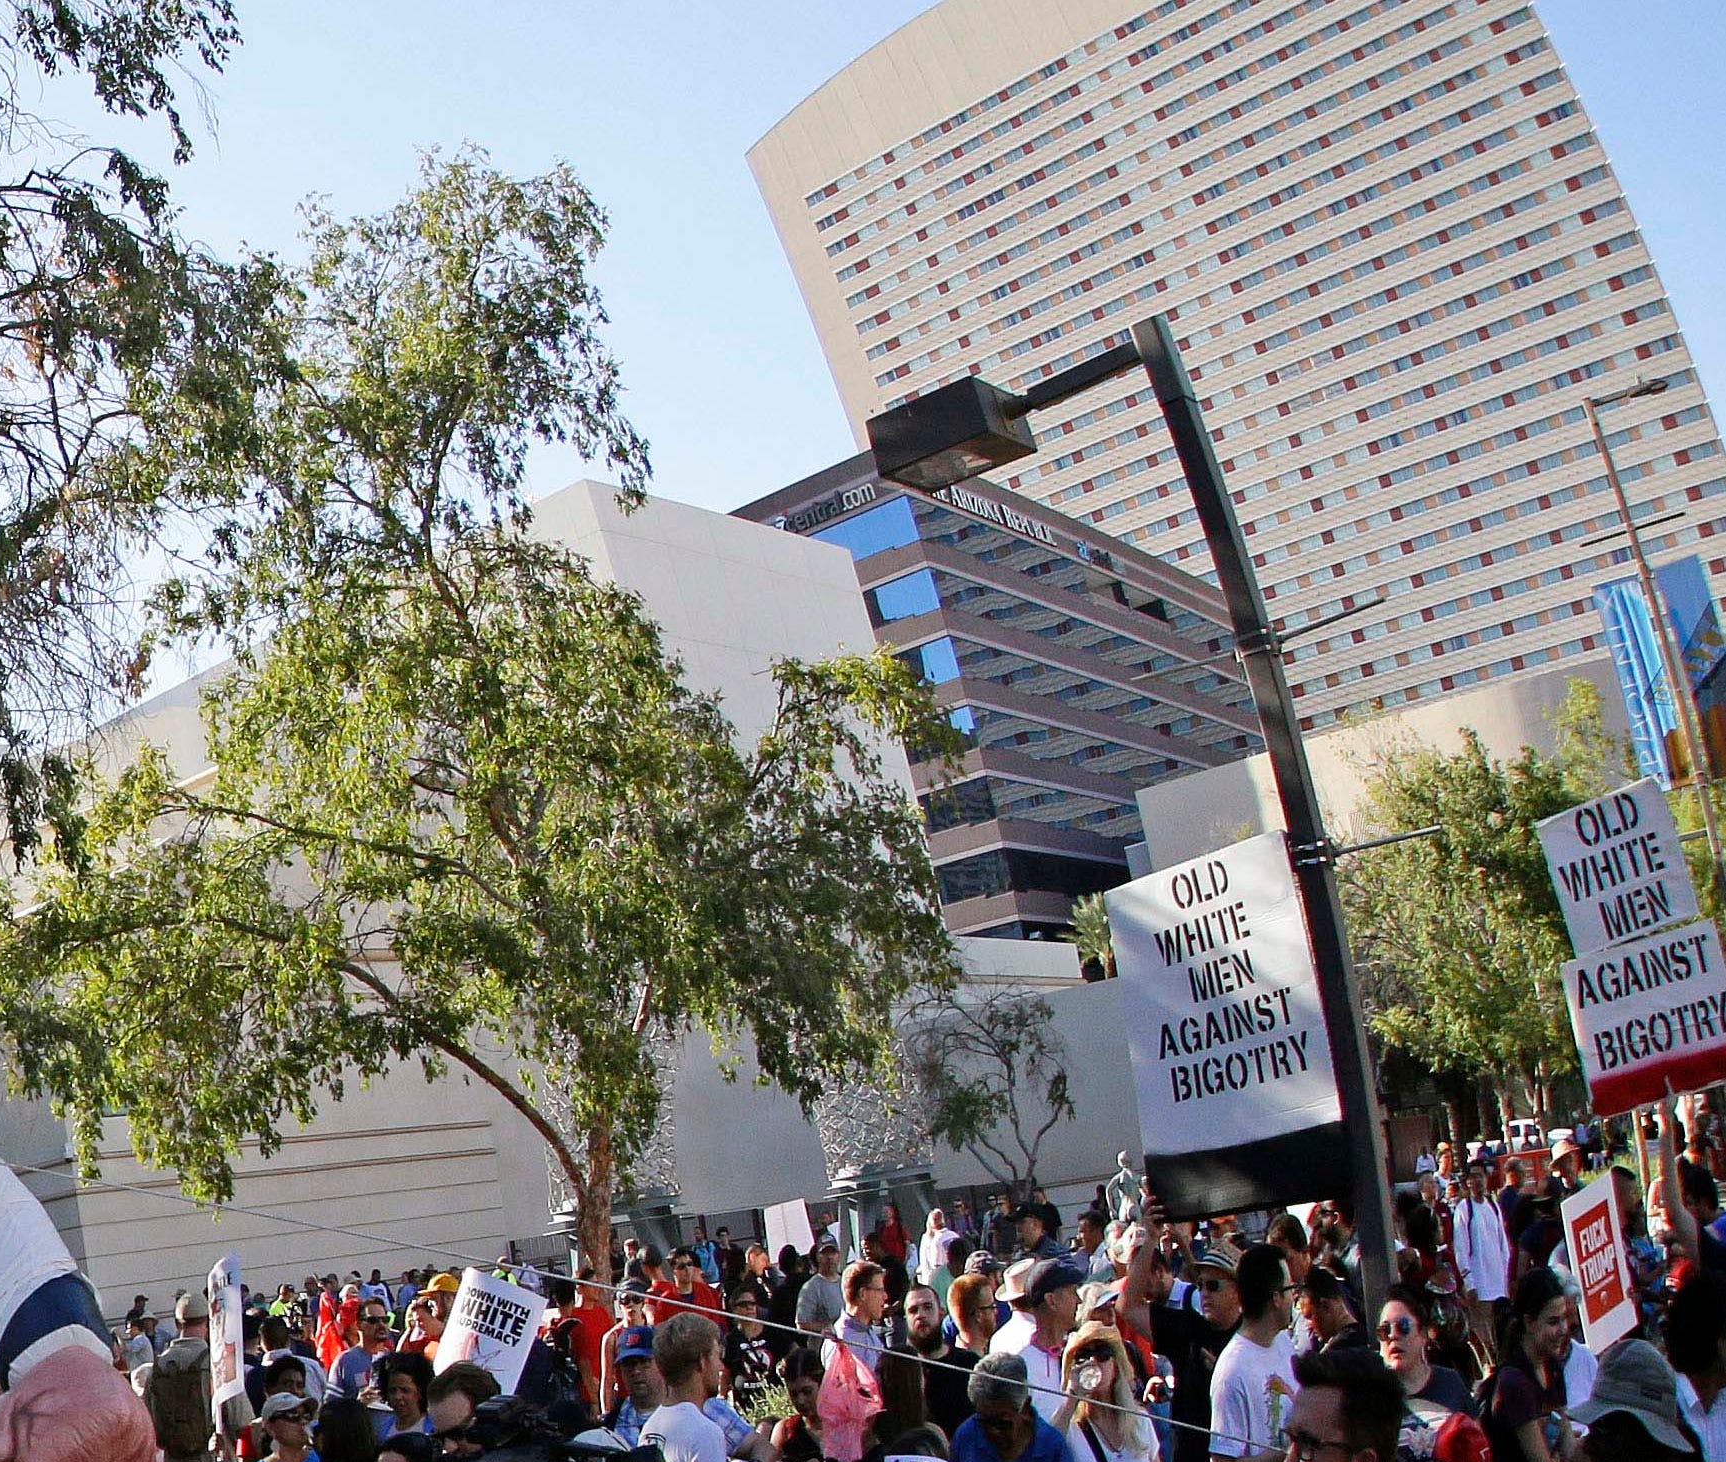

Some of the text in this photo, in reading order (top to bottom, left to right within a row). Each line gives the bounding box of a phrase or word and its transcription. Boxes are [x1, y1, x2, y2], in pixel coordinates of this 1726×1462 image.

[1573, 792, 1640, 848] OLD
[1171, 860, 1230, 911] OLD
[1557, 830, 1667, 902] WHITE
[1154, 900, 1251, 968] WHITE
[1597, 882, 1673, 942] MEN
[1188, 947, 1255, 1004] MEN
[1576, 933, 1709, 1010] AGAINST
[1157, 987, 1293, 1060] AGAINST
[1593, 991, 1726, 1072] BIGOTRY
[1169, 1031, 1310, 1103] BIGOTRY
[1579, 1216, 1609, 1258] FUCK
[1580, 1243, 1615, 1289] TRUMP
[459, 1317, 520, 1347] UPREMACY
[460, 1297, 527, 1338] WHITE
[496, 1296, 531, 1320] WITH
